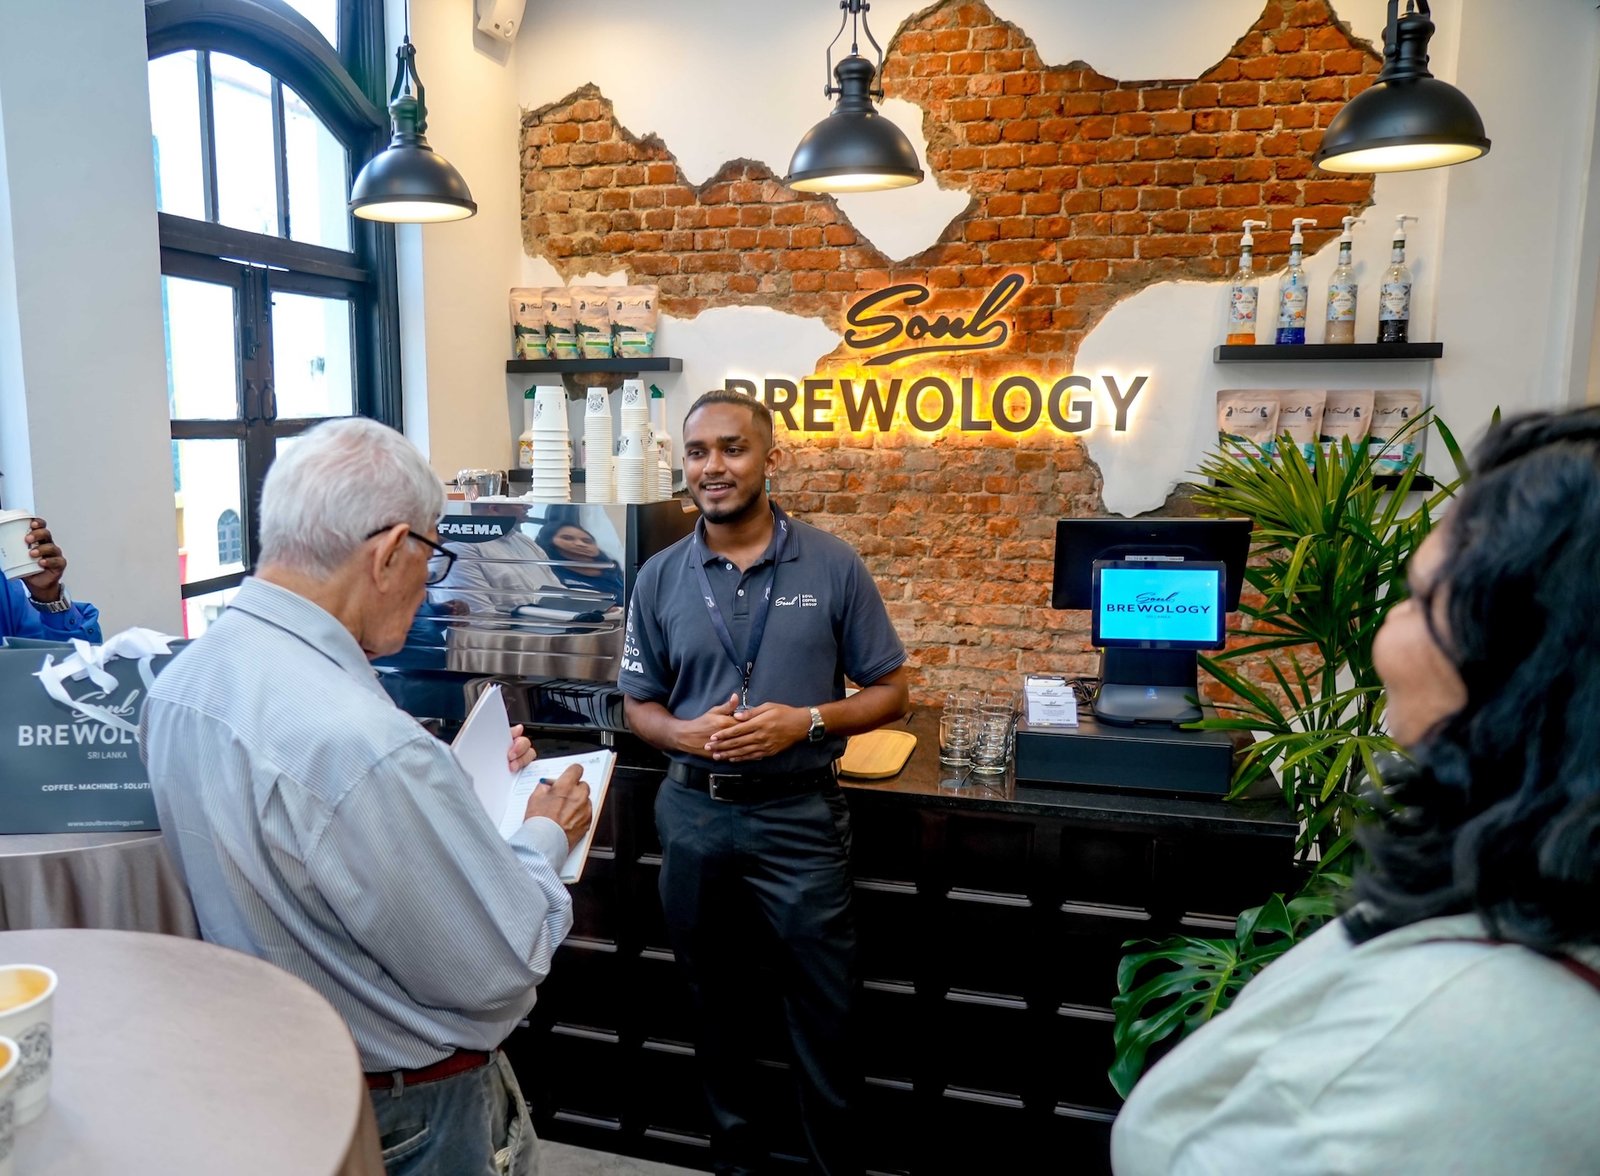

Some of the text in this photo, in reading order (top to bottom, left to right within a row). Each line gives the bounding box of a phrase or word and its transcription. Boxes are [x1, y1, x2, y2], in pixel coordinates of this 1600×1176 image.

[844, 273, 1024, 366] Soul
[437, 523, 503, 536] FAEMA
[775, 596, 798, 607] Soul
[1135, 592, 1180, 604] Soul
[1106, 604, 1211, 614] BREWOLOGY
[18, 724, 141, 746] BREWOL
[87, 751, 128, 760] SRI LANKA
[78, 782, 119, 791] MACHINES
